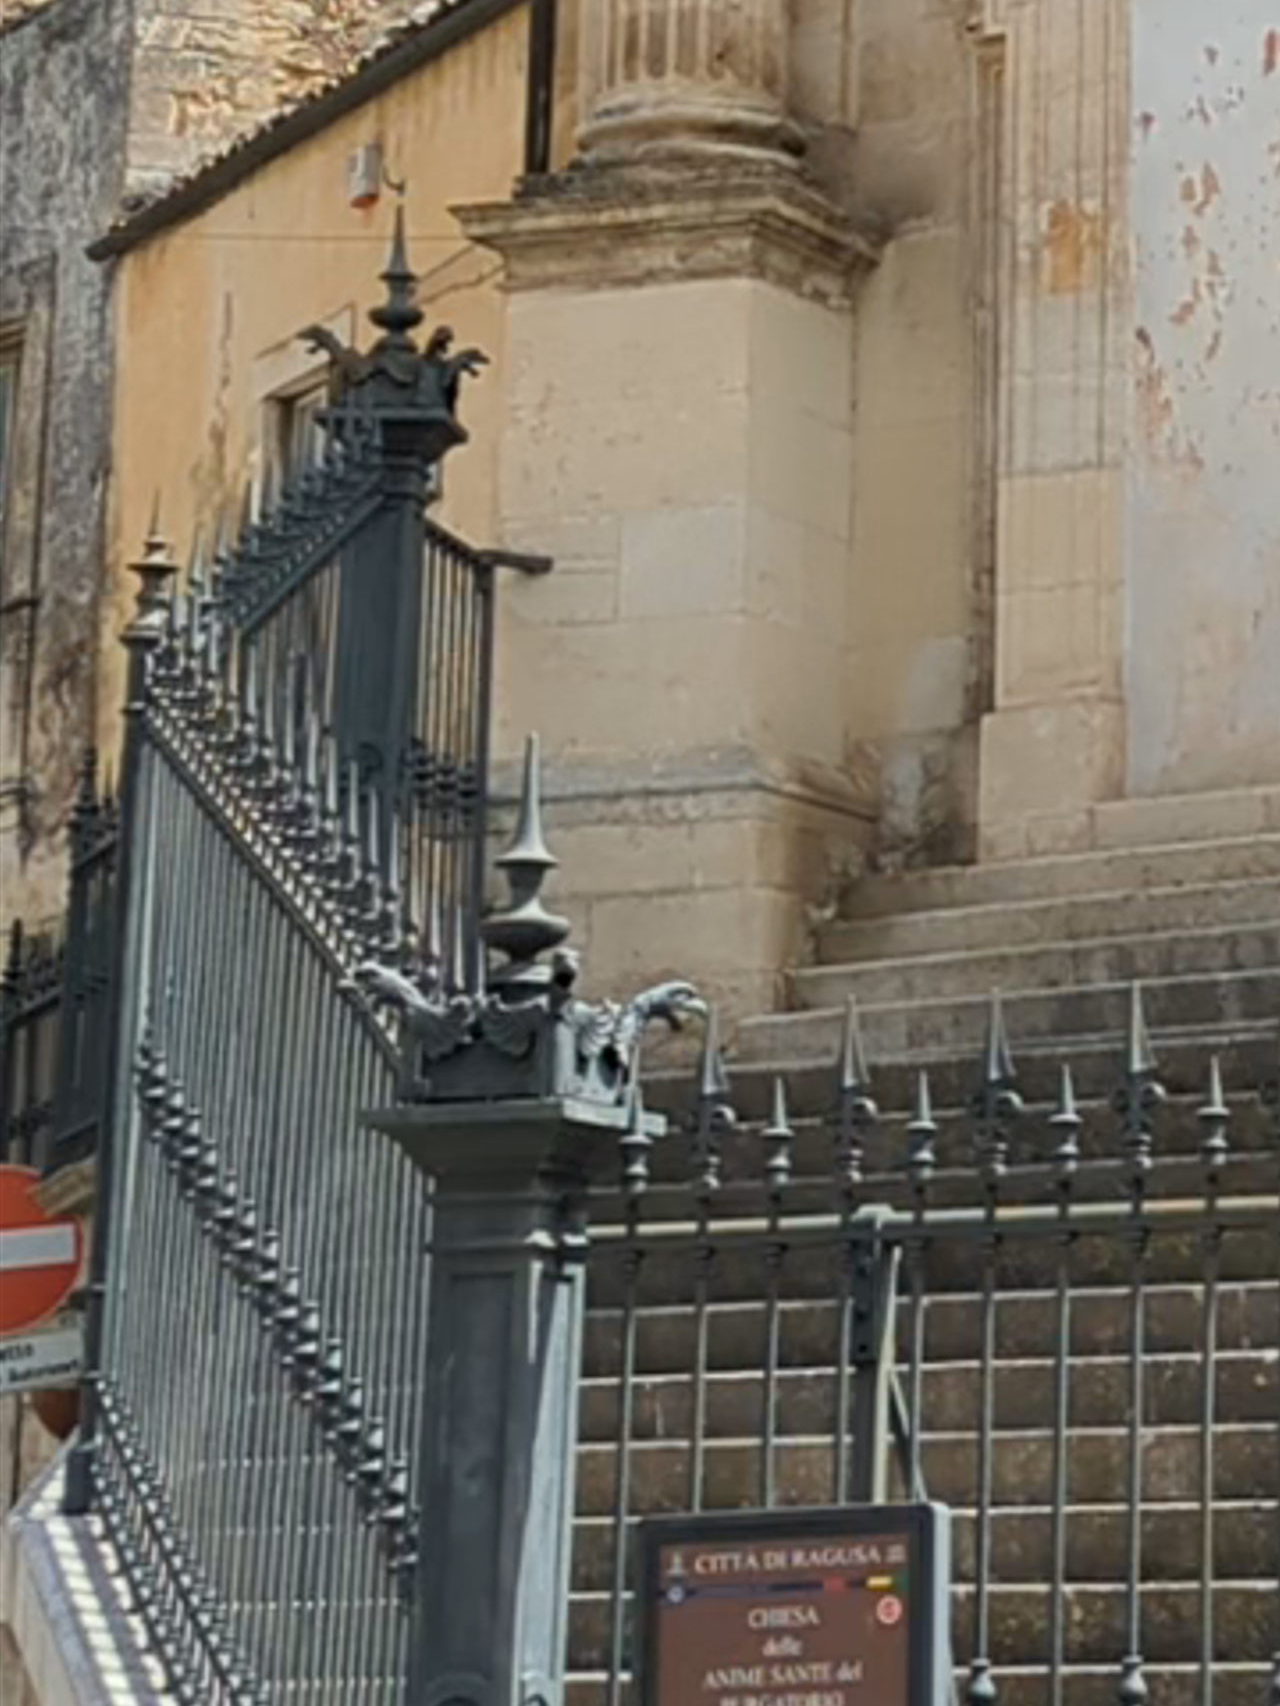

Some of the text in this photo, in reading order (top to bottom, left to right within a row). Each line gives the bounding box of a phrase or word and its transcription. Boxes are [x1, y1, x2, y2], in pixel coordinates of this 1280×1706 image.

[763, 1548, 788, 1572] DI
[790, 1544, 881, 1568] RAGUSA
[748, 1605, 820, 1628] CHIESA
[762, 1635, 802, 1656] delle
[703, 1666, 765, 1689] ANIME
[768, 1660, 832, 1685] SANTE
